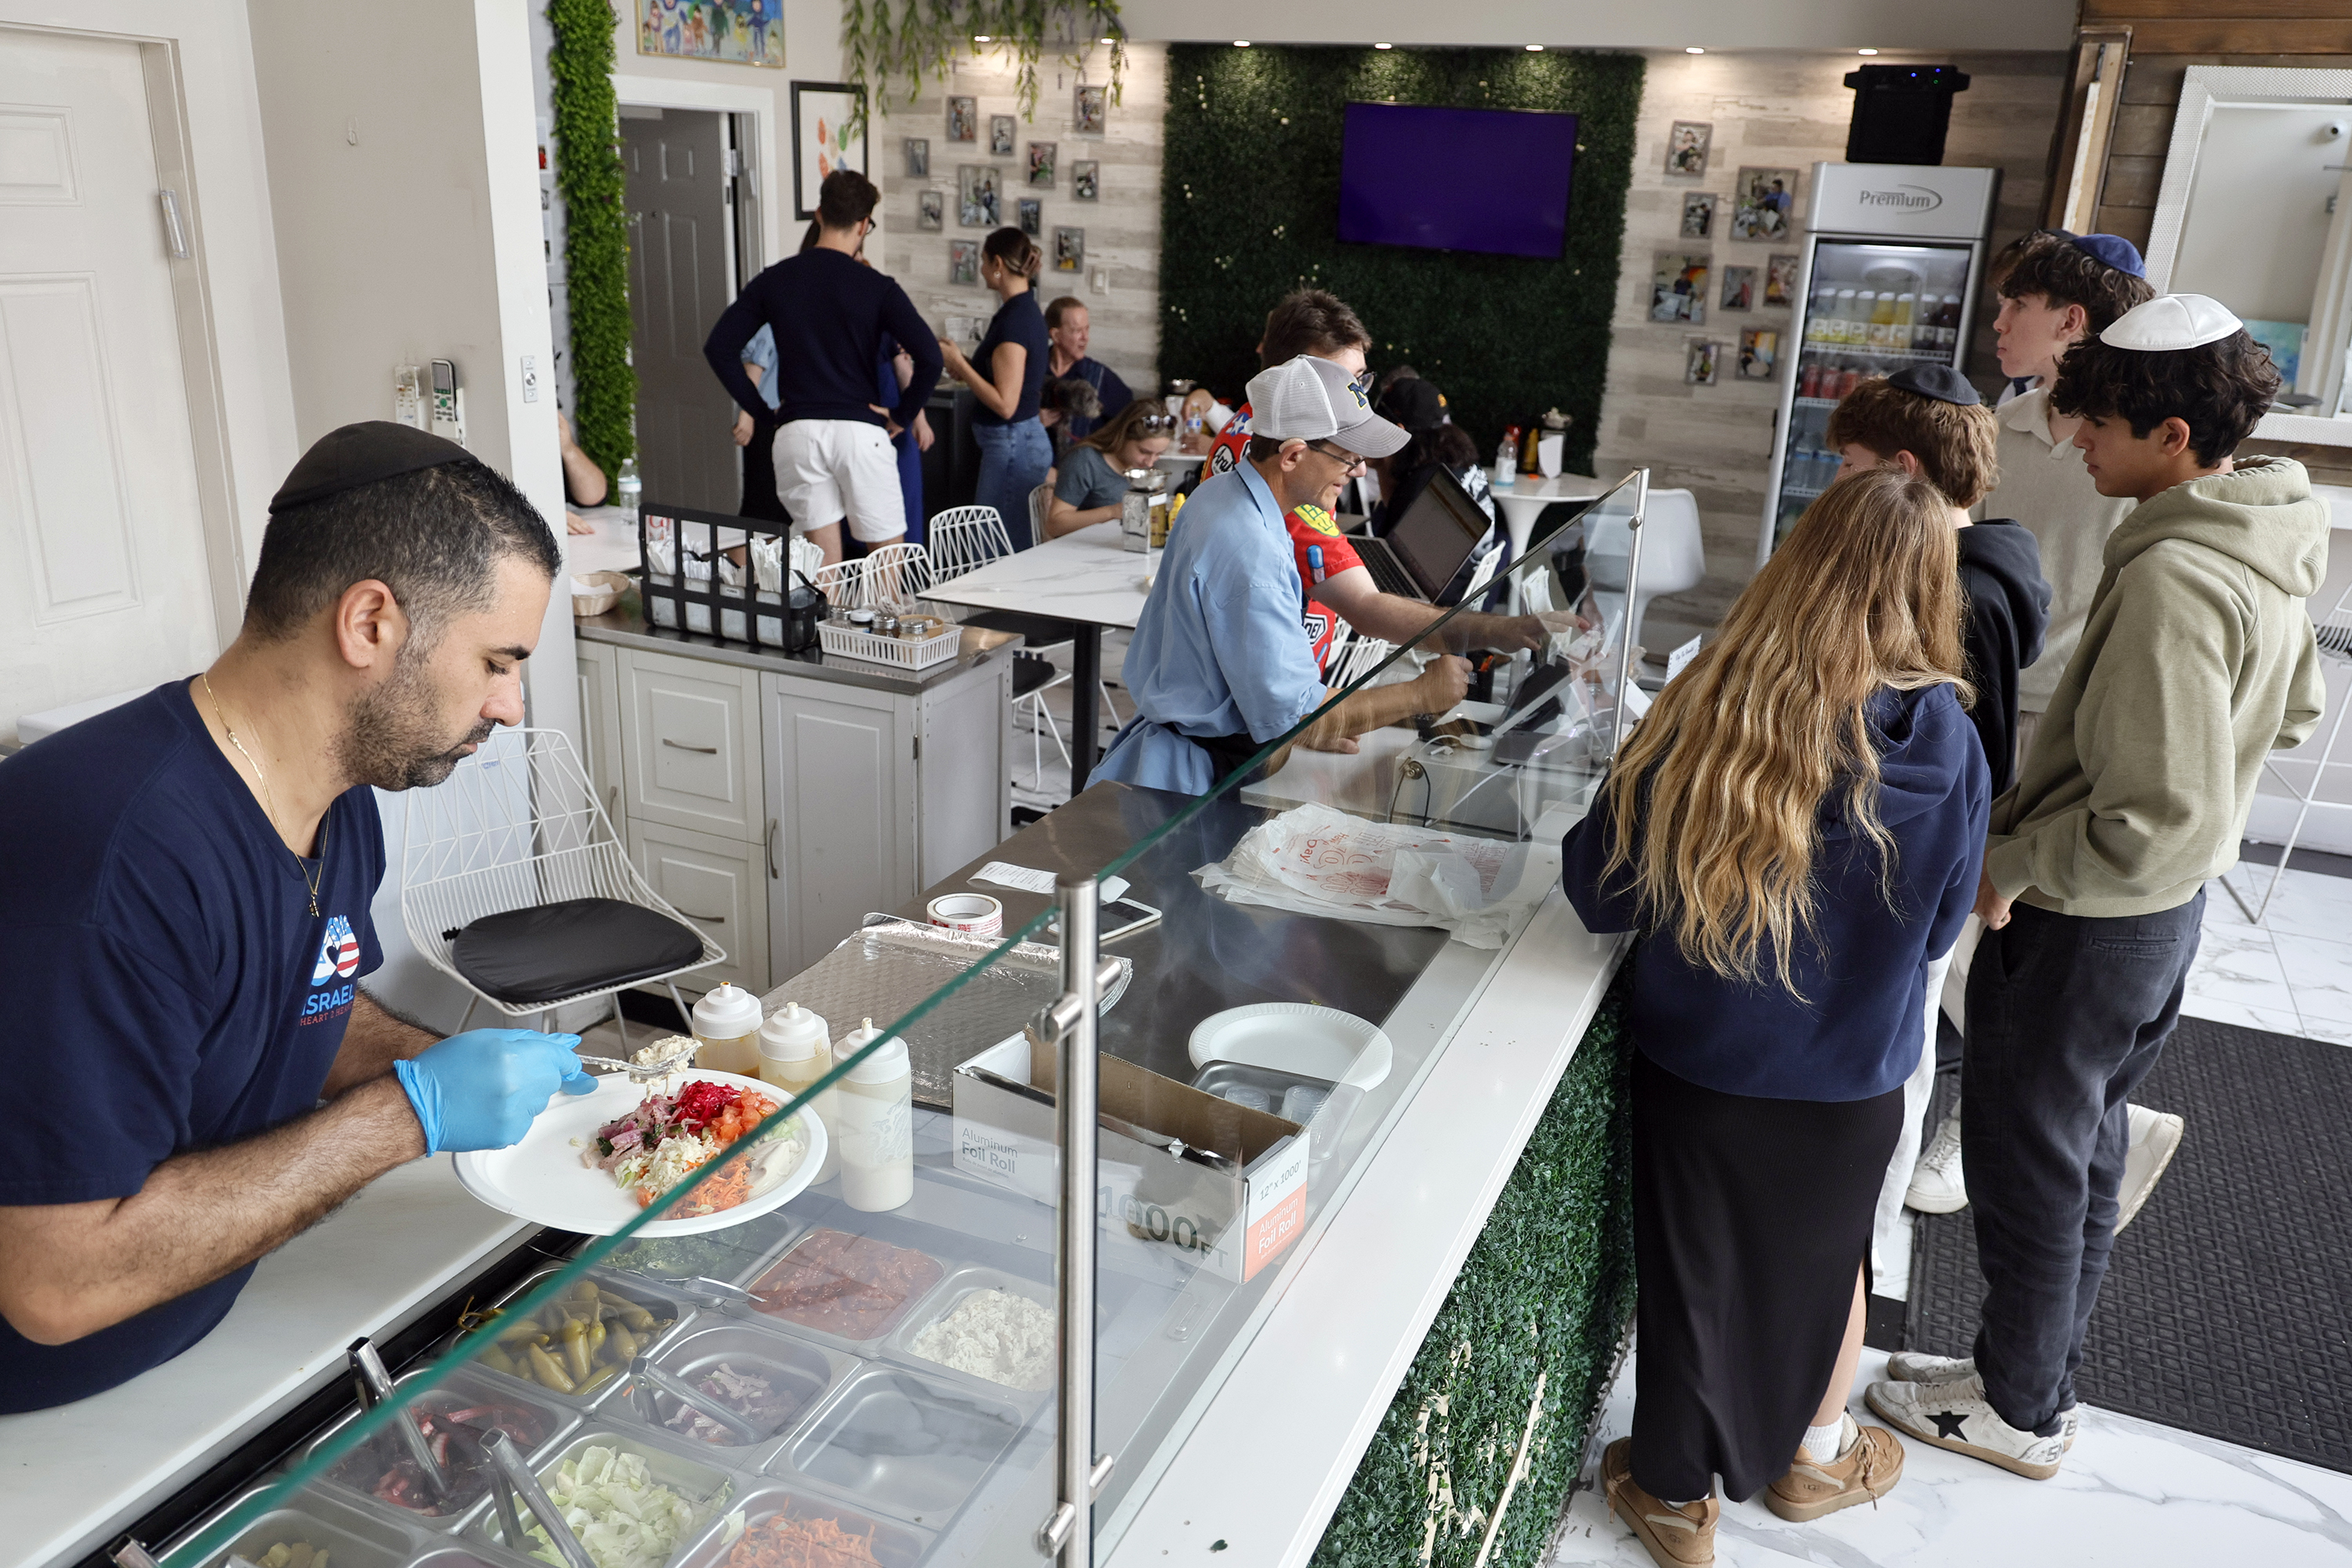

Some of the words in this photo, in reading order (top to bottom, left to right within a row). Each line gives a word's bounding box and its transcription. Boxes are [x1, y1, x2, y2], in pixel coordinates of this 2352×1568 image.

[1859, 190, 1930, 208] Premium
[1299, 839, 1319, 865] Day!
[302, 984, 354, 1016] ISRAEL
[299, 1012, 329, 1026] HEART
[330, 1010, 335, 1018] 2
[962, 1127, 1018, 1158] Aluminum
[962, 1141, 985, 1162] Foil
[990, 1152, 1015, 1174] Roll
[1258, 1198, 1298, 1237] Aluminum
[1258, 1227, 1276, 1254] Foil
[1279, 1210, 1297, 1237] Roll
